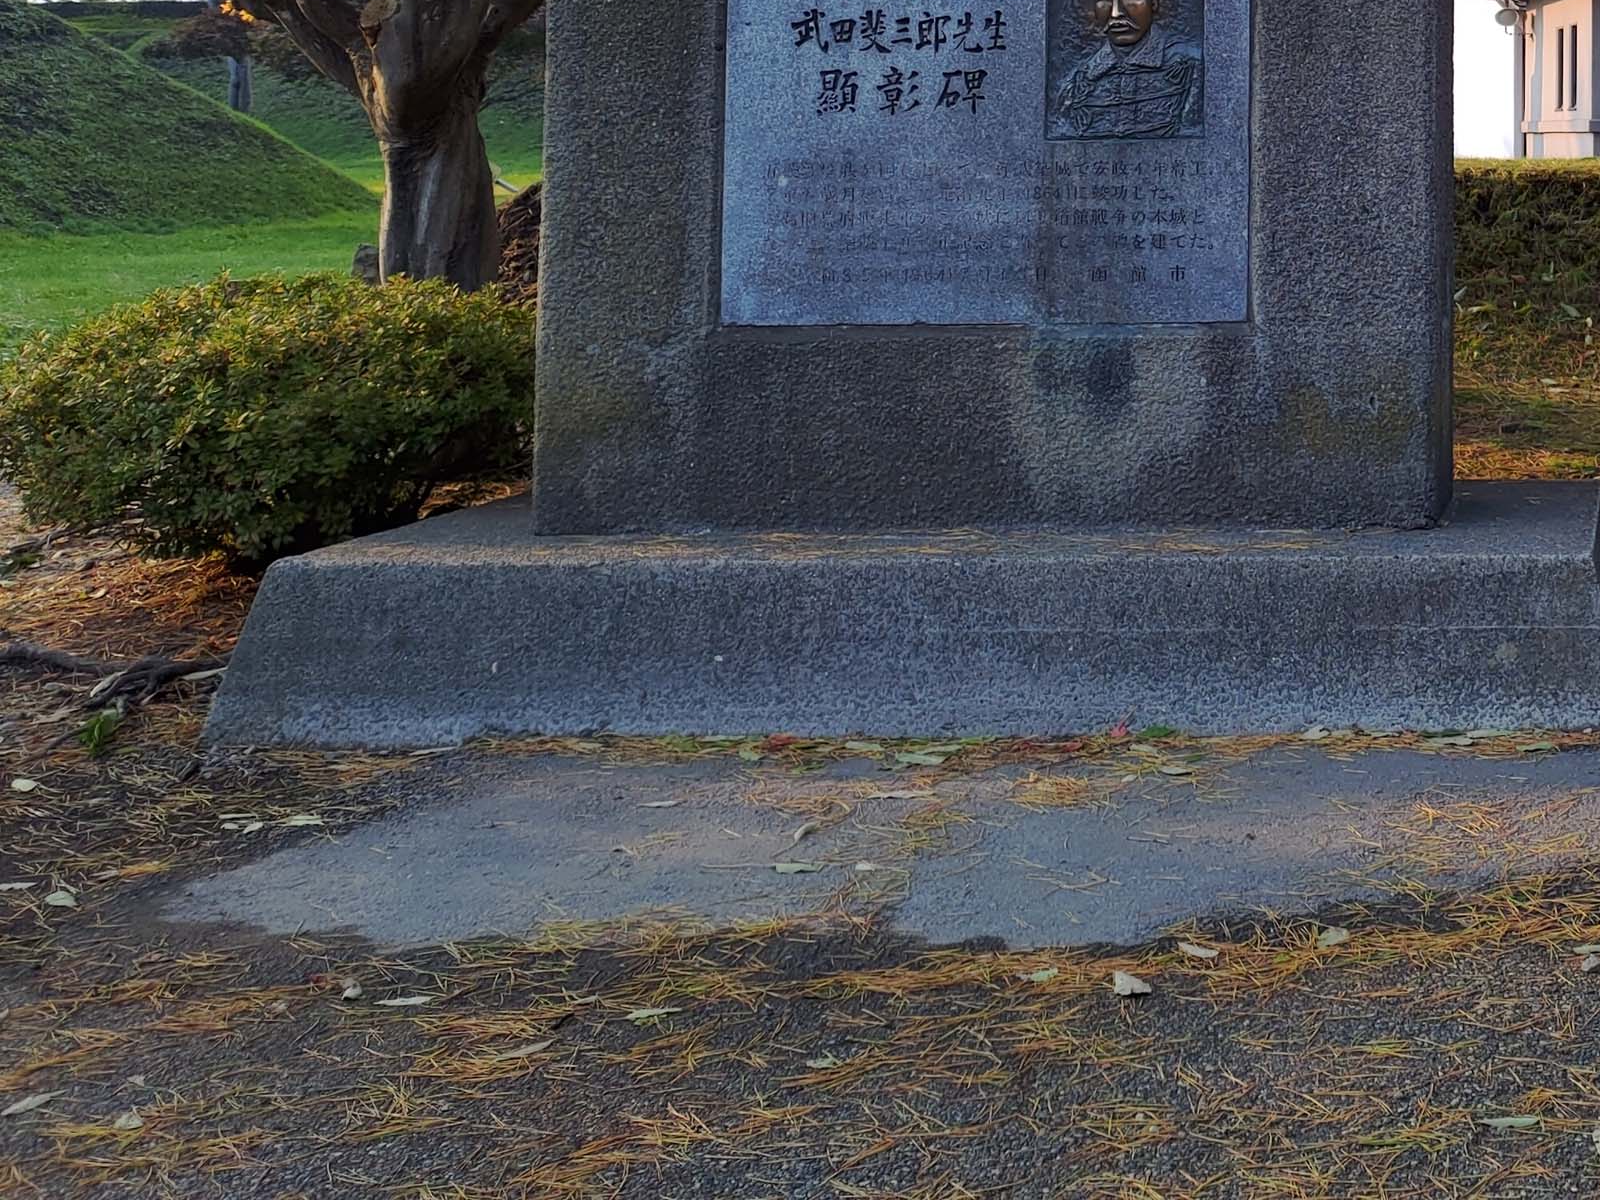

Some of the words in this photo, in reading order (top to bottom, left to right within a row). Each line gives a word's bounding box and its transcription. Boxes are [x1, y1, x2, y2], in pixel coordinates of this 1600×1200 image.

[791, 8, 1009, 55] 武田斐三郎先生
